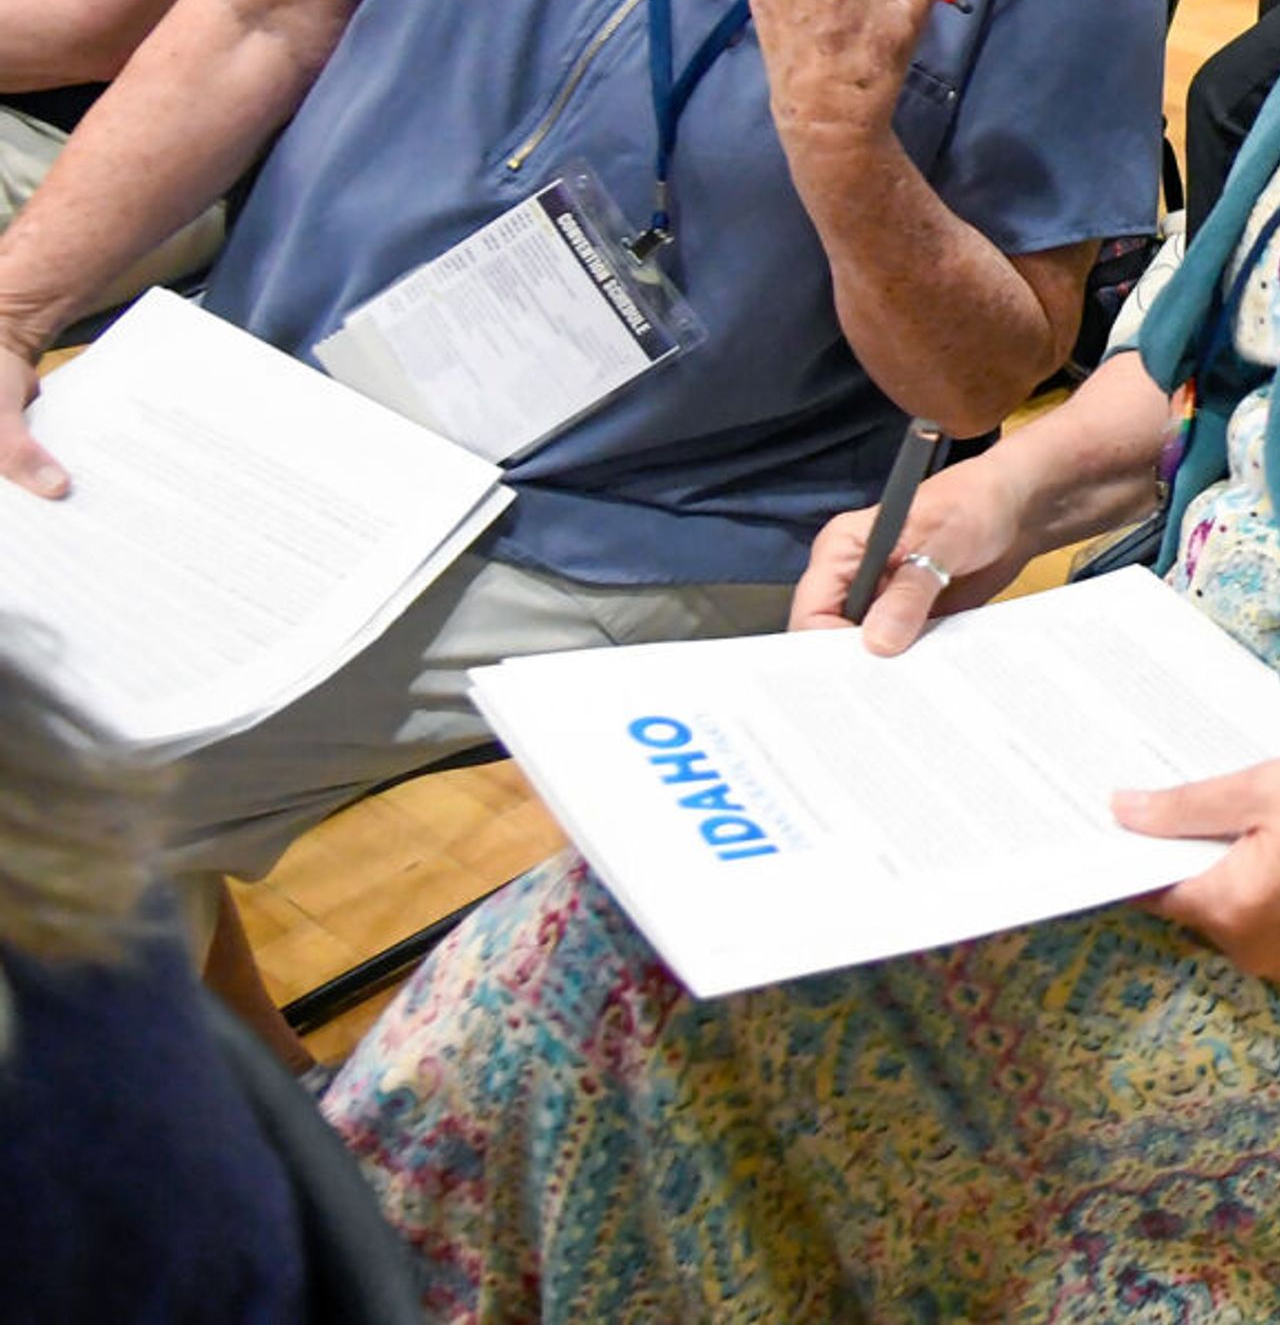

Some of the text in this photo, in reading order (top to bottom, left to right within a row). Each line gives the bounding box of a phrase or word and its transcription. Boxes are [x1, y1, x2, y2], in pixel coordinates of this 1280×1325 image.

[556, 212, 652, 336] CONVENTION SCHEDULE
[625, 714, 782, 863] IDAHO
